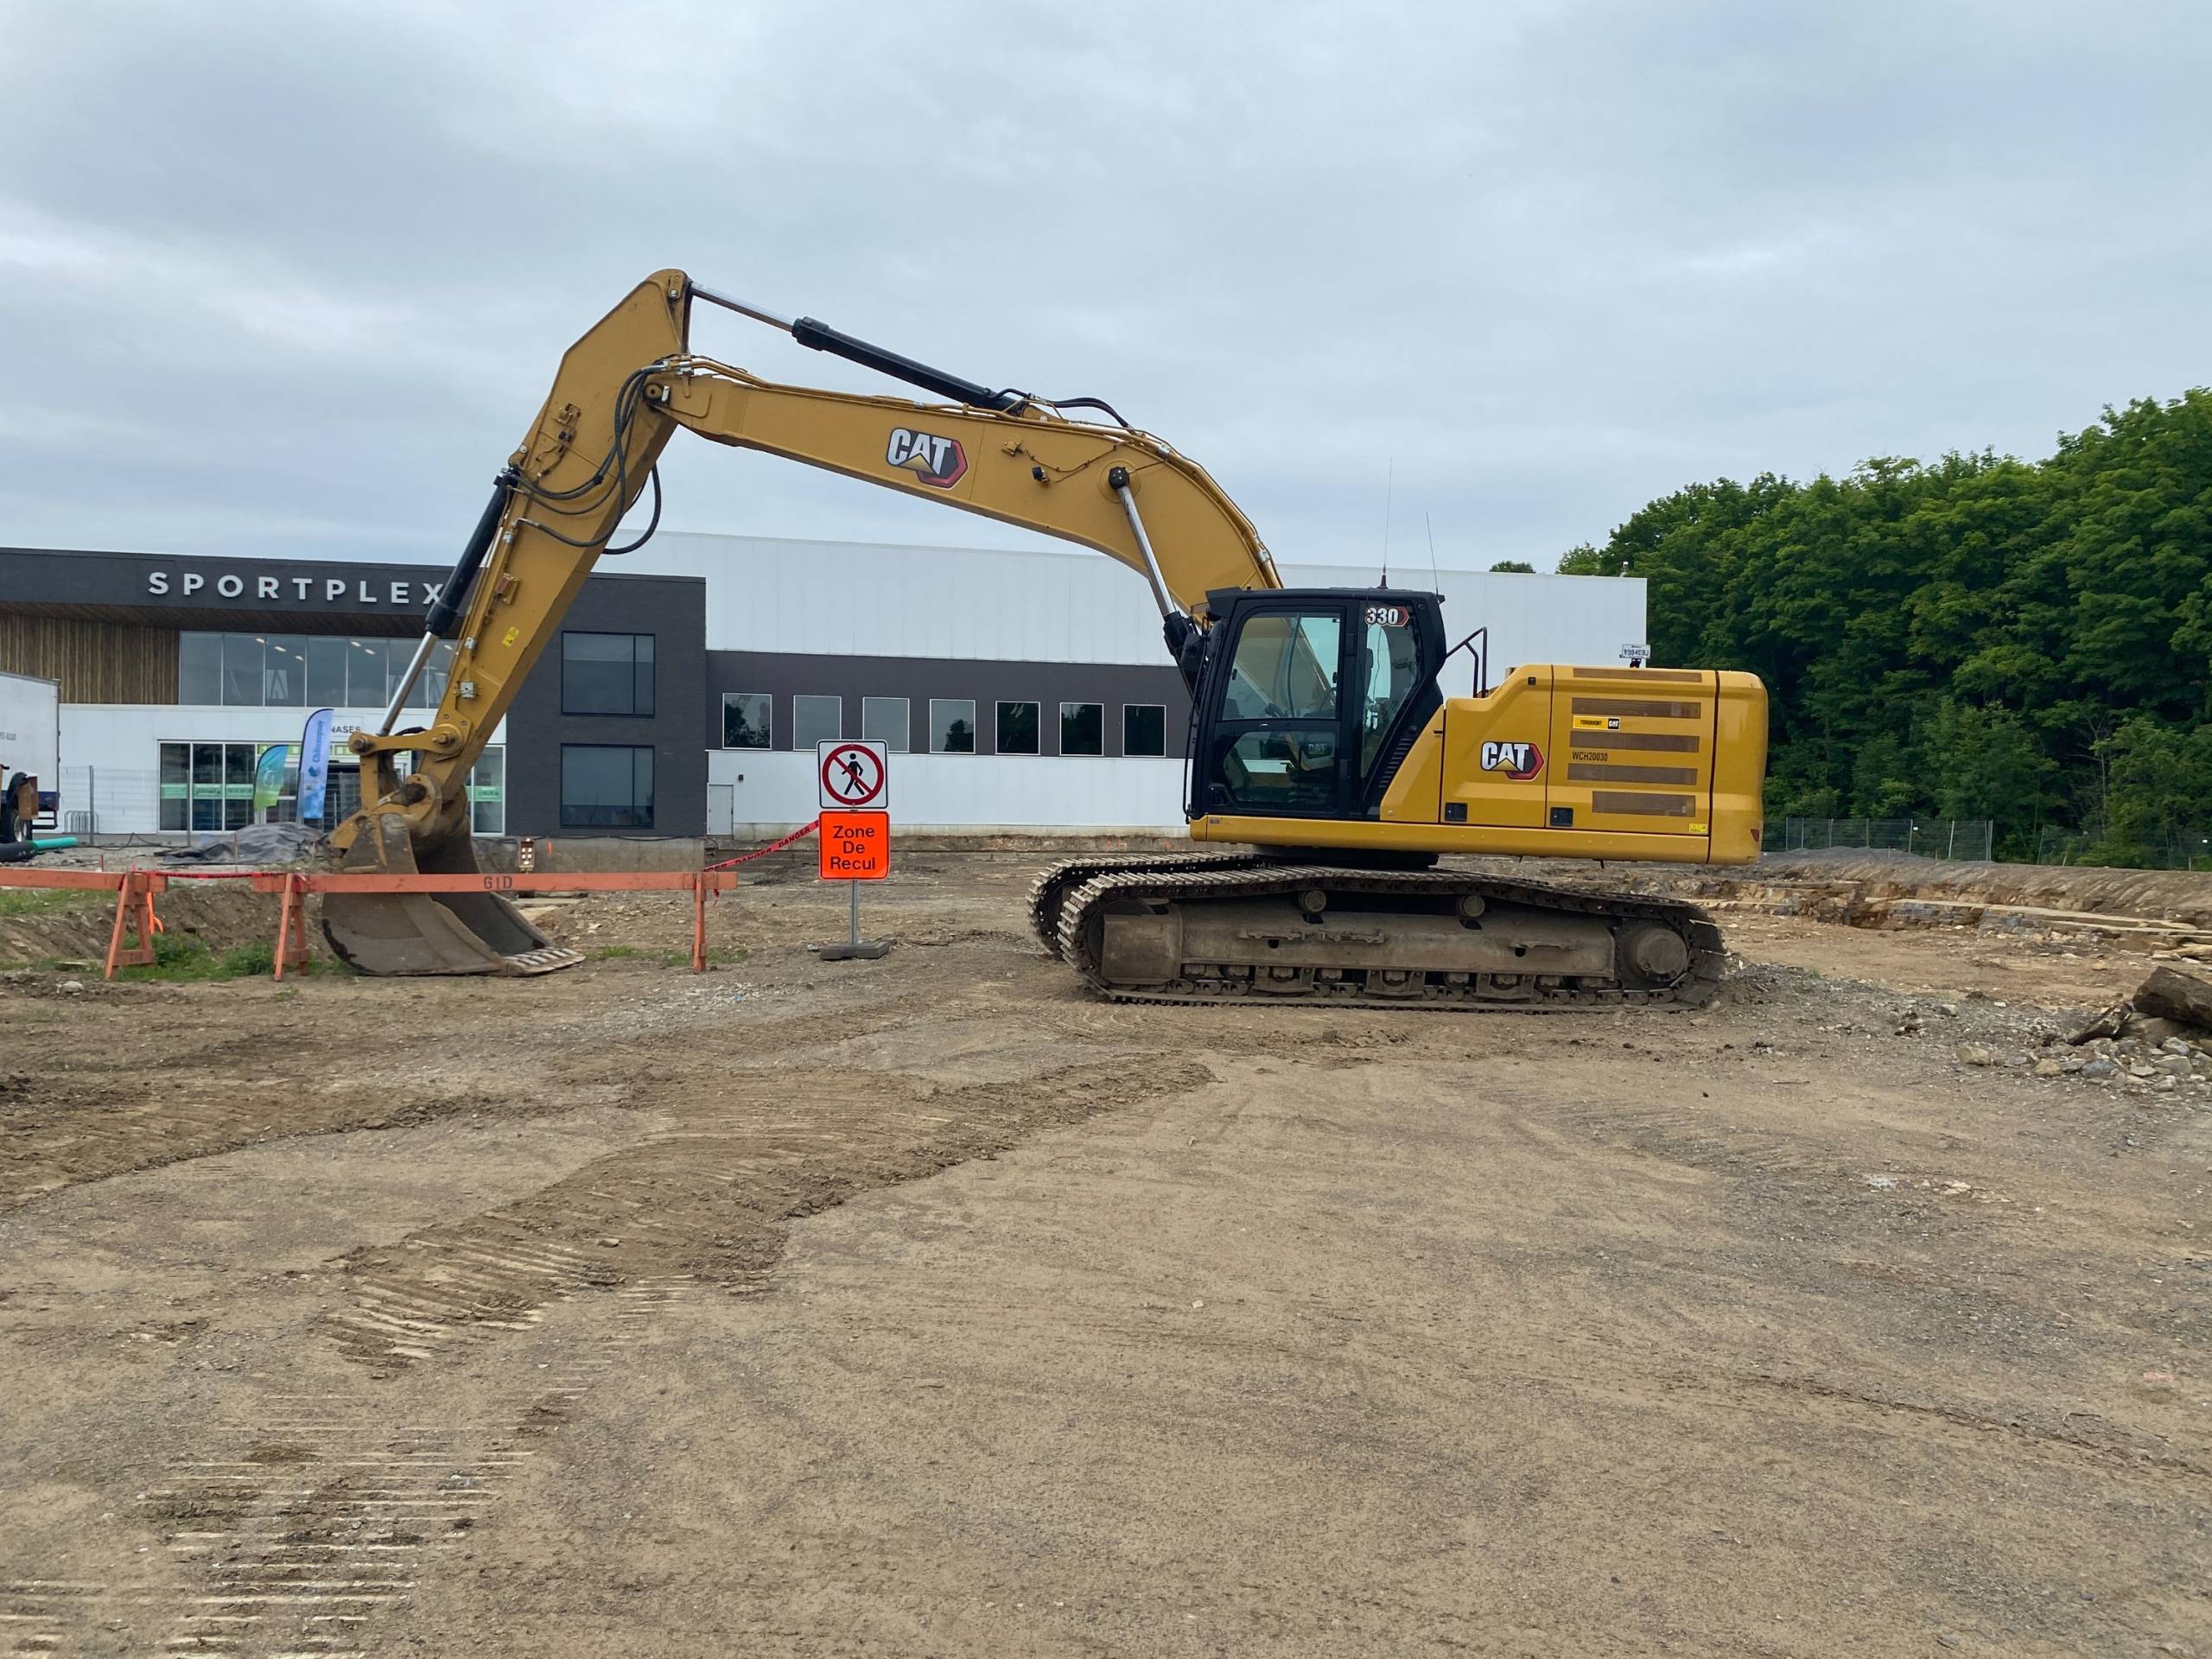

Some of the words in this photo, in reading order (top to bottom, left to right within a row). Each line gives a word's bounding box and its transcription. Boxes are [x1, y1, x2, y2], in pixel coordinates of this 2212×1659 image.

[887, 429, 952, 475] CAT
[148, 571, 444, 605] SPORTPLEX
[1366, 607, 1399, 625] 330
[1482, 742, 1529, 772] CAT
[1572, 751, 1608, 762] WCH20030
[778, 826, 811, 849] DANGER
[832, 825, 875, 839] Zone
[842, 841, 866, 854] De
[830, 856, 876, 870] Recul
